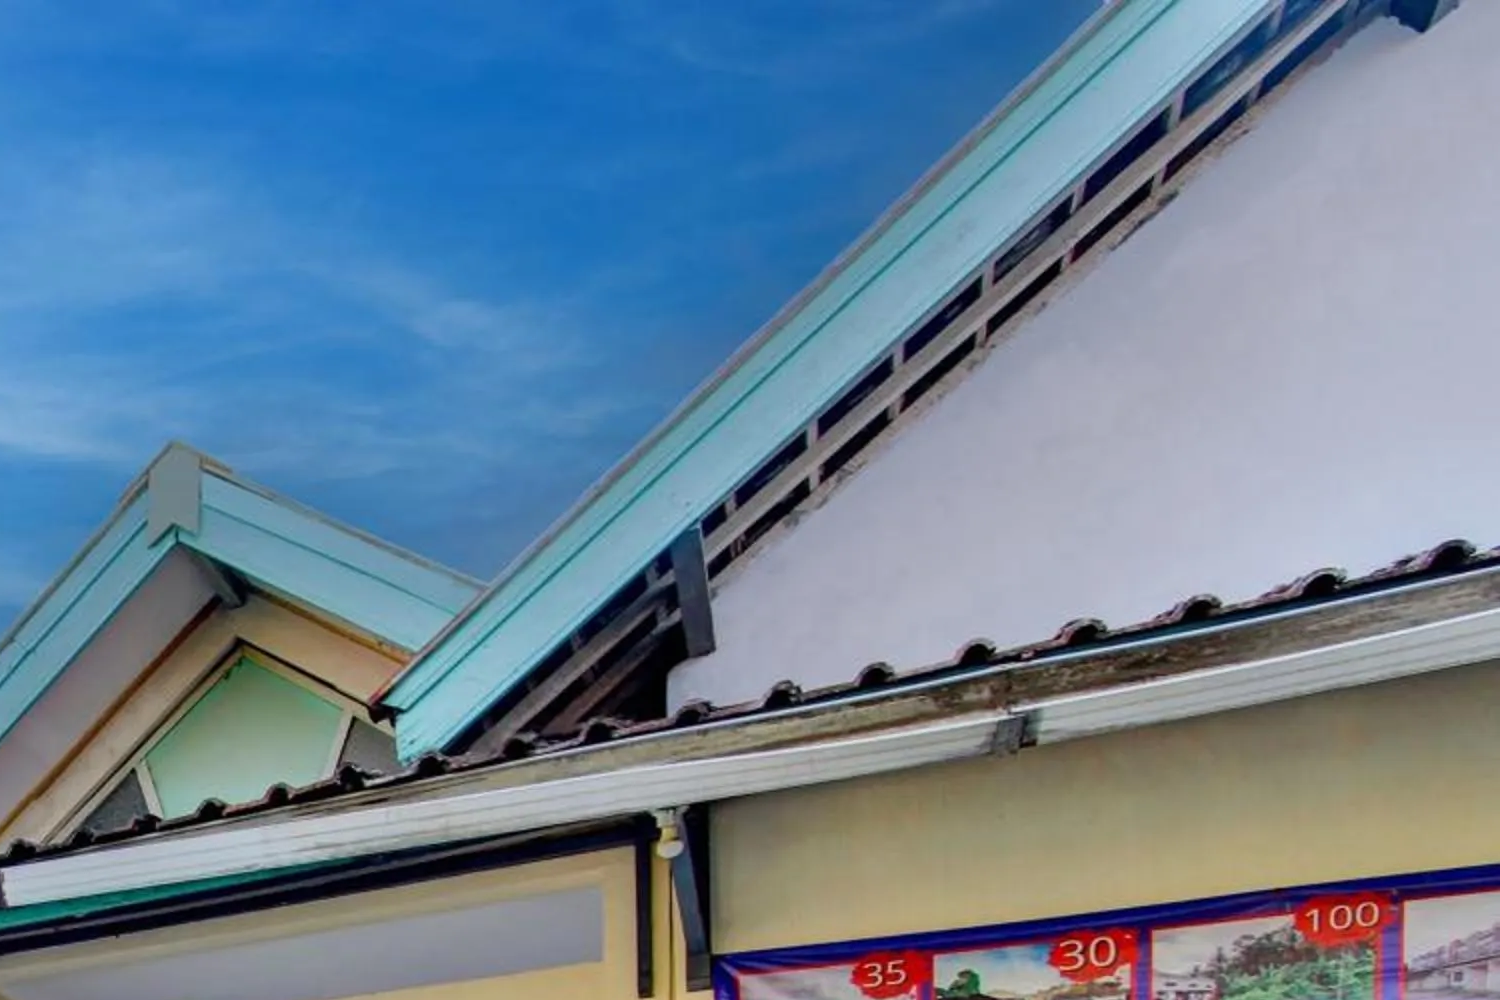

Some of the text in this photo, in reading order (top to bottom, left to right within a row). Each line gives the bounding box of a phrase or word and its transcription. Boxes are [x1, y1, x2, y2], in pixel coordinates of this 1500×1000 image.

[1305, 901, 1380, 932] 100
[1059, 936, 1117, 972] 30
[863, 959, 908, 988] 35
